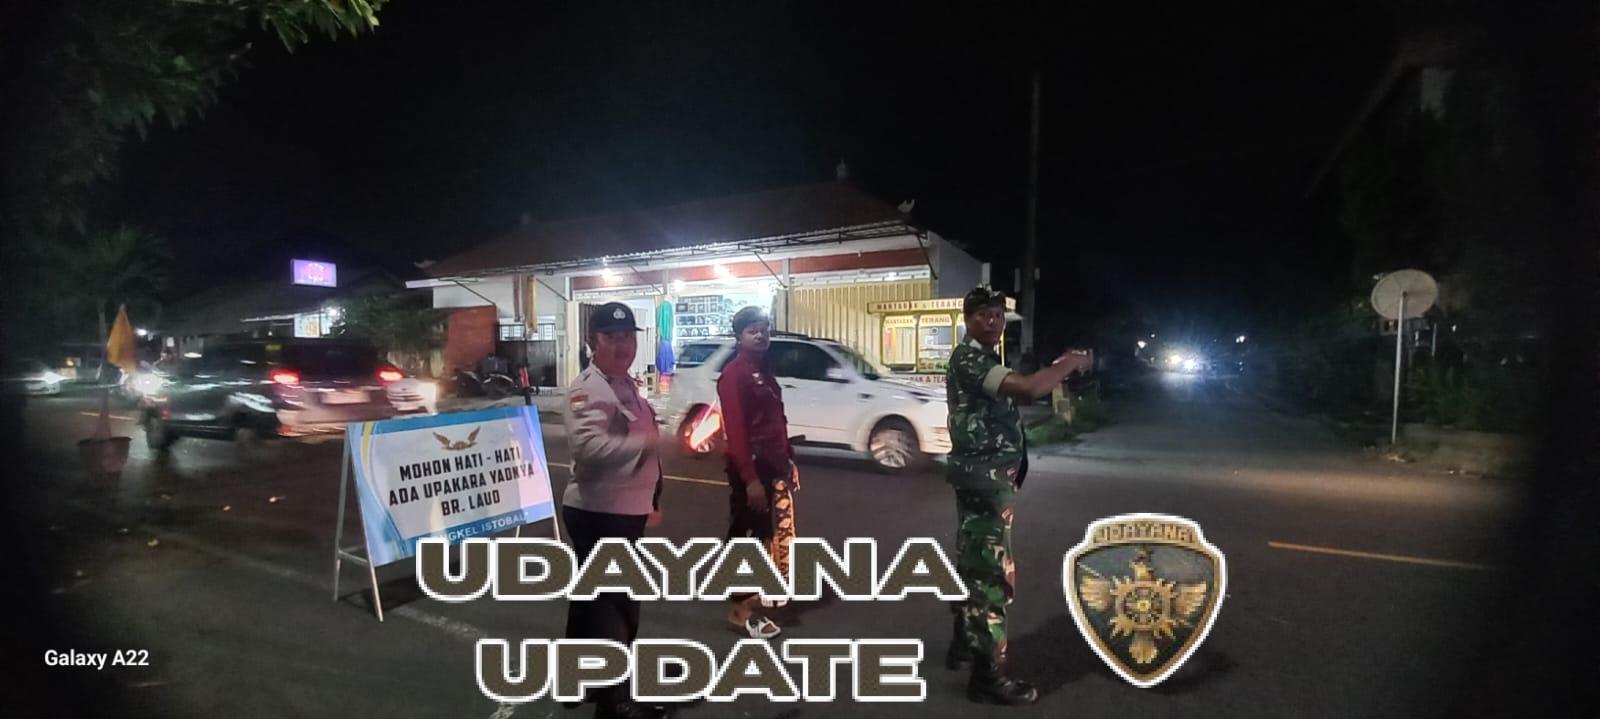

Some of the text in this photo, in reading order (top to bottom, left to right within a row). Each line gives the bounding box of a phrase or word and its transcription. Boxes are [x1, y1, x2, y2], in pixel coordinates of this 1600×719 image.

[399, 460, 451, 482] MOHON
[455, 452, 483, 472] HATI
[494, 446, 521, 464] HATI
[388, 487, 420, 507] ADA
[423, 473, 487, 499] UPAKARA
[441, 489, 501, 517] BR. LAUD
